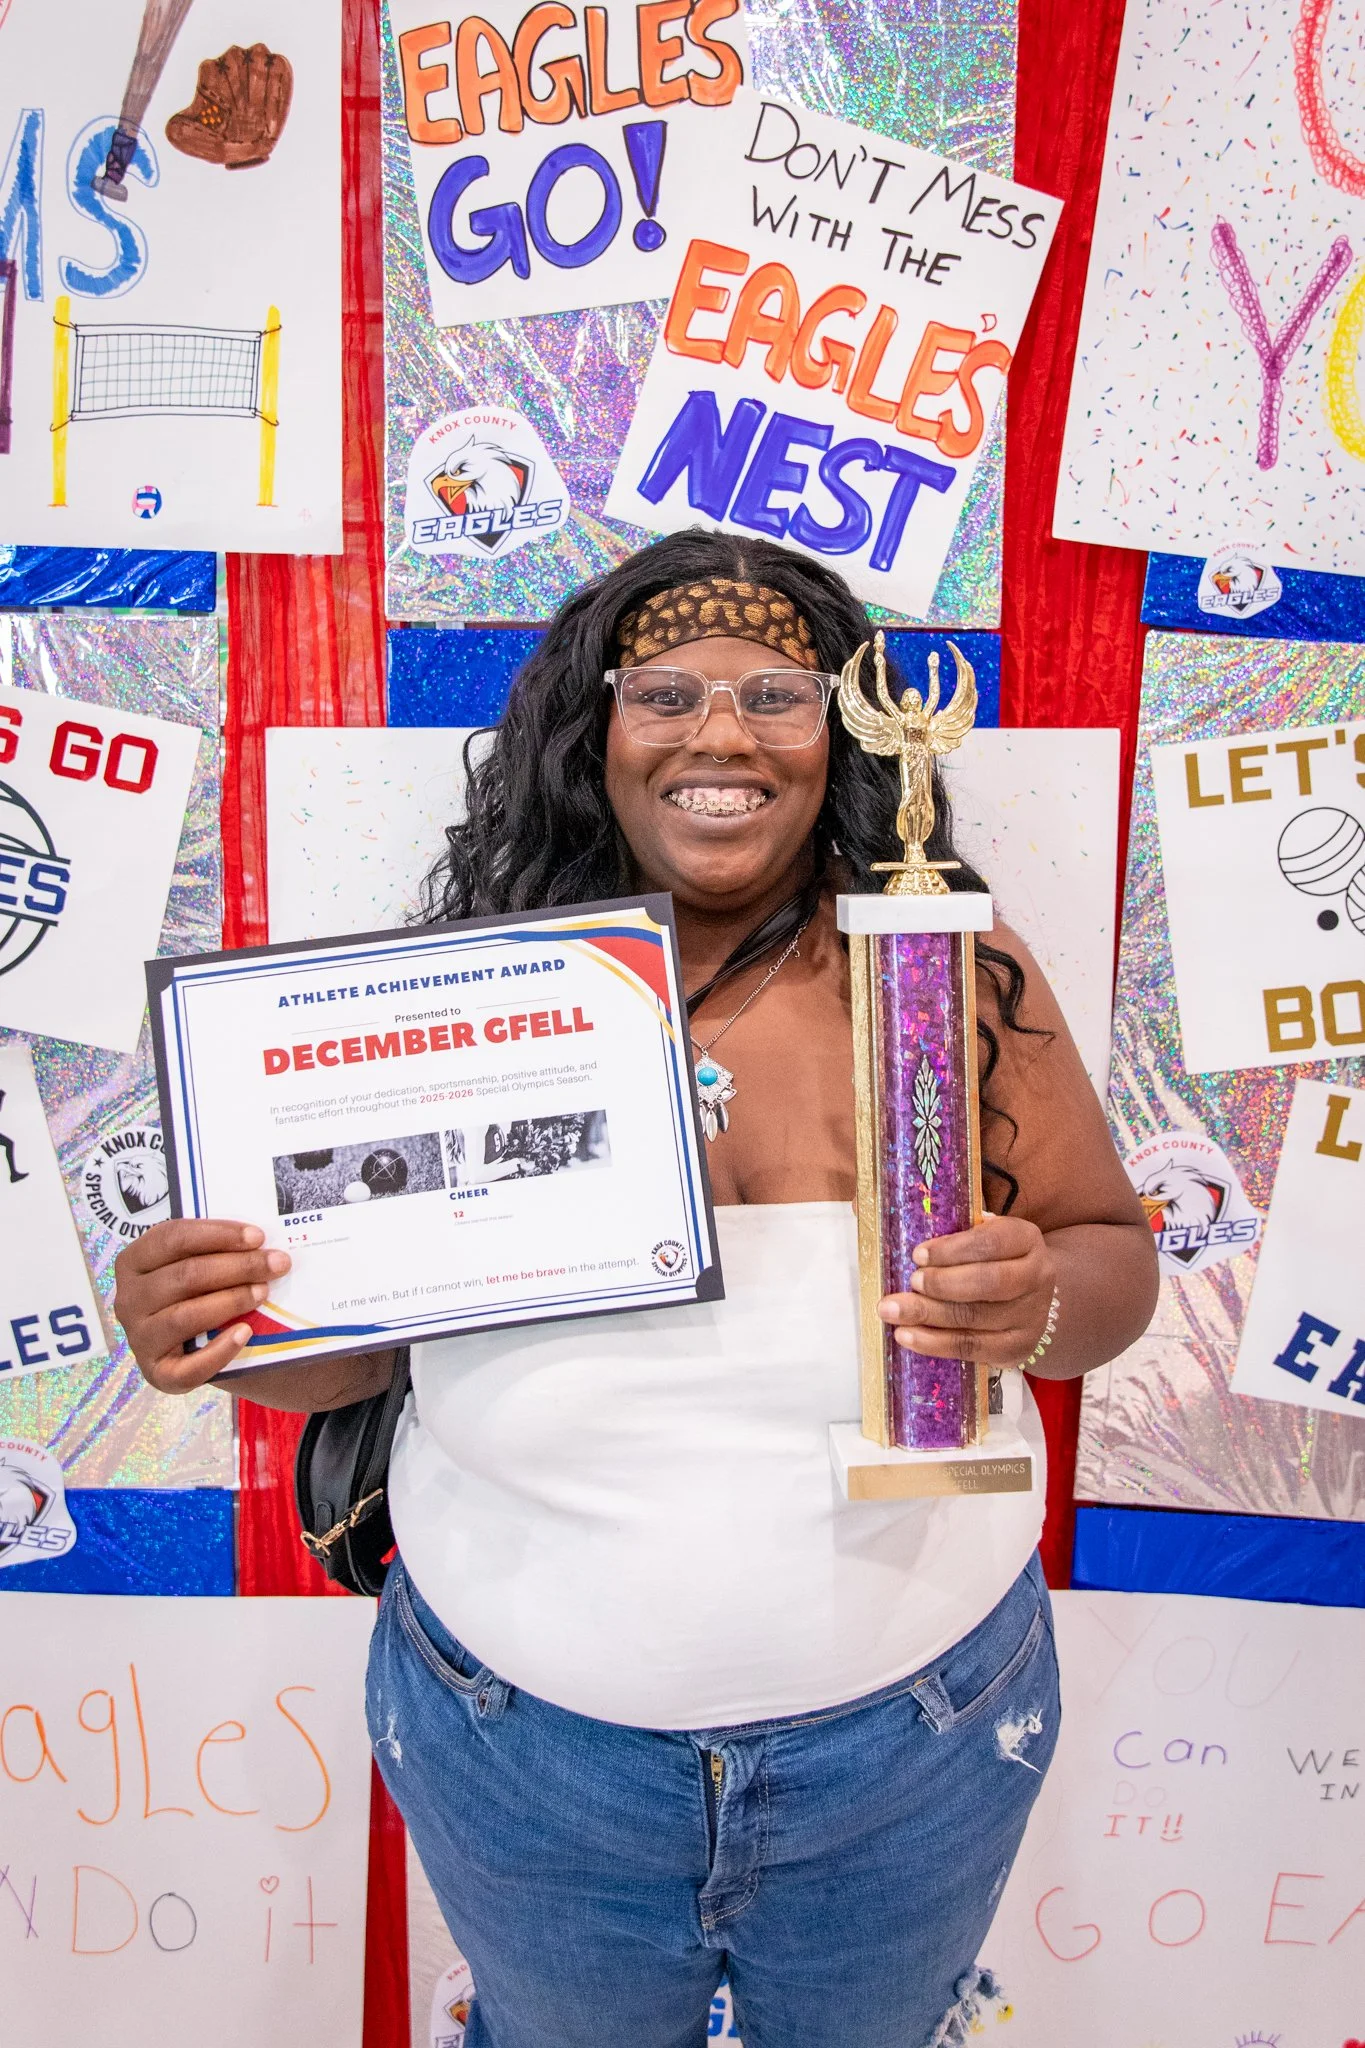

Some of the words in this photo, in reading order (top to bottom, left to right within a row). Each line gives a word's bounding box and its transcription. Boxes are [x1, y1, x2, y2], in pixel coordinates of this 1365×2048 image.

[398, 0, 744, 145] EAGLES
[745, 102, 905, 203] DON'T
[909, 166, 1045, 249] MESS
[428, 121, 668, 285] GO!
[752, 185, 852, 251] WITH
[882, 227, 961, 286] THE
[429, 420, 460, 444] KNOX
[464, 415, 517, 430] COUNTY
[637, 391, 956, 572] NEST
[412, 499, 562, 544] EAGLES
[1231, 543, 1259, 551] COUNTY
[1200, 587, 1279, 610] EAGLES
[49, 721, 158, 794] GO
[278, 986, 360, 1008] ATHLETE
[365, 968, 495, 996] ACHIEVEMENT
[500, 958, 566, 978] AWARD
[394, 1007, 448, 1023] Presented
[449, 1006, 461, 1016] to
[263, 1021, 477, 1076] DECEMBER
[483, 1006, 594, 1044] GFELL
[270, 1106, 280, 1115] In
[281, 1096, 337, 1112] recognition
[338, 1095, 349, 1104] of
[350, 1092, 372, 1104] your
[374, 1085, 427, 1100] dedication,
[428, 1075, 500, 1093] sportsmanship,
[501, 1069, 538, 1082] positive
[539, 1065, 578, 1077] attitude,
[579, 1060, 597, 1071] and
[275, 1112, 317, 1125] fantastic
[318, 1107, 344, 1119] effort
[346, 1100, 400, 1114] throughout
[402, 1096, 417, 1107] the
[420, 1089, 474, 1104] 2025-2026
[476, 1083, 510, 1096] Special
[511, 1078, 554, 1093] Olympics
[556, 1074, 593, 1085] Season.
[101, 1132, 146, 1158] KNOX
[1128, 1144, 1158, 1167] KNOX
[1162, 1140, 1214, 1154] COUNTY
[85, 1172, 118, 1230] SPECIAL
[284, 1214, 323, 1227] BOCCE
[449, 1188, 489, 1200] CHEER
[453, 1210, 464, 1219] 12
[1156, 1218, 1257, 1252] GLES
[331, 1300, 348, 1311] Let
[350, 1297, 366, 1307] me
[368, 1293, 390, 1305] win.
[392, 1289, 409, 1300] But
[411, 1286, 418, 1297] if
[425, 1280, 461, 1295] cannot
[463, 1278, 484, 1289] win,
[486, 1274, 500, 1285] let
[502, 1272, 519, 1282] me
[521, 1270, 534, 1280] be
[536, 1266, 566, 1278] brave
[568, 1265, 578, 1274] in
[579, 1262, 596, 1273] the
[598, 1257, 639, 1271] attempt.
[942, 1464, 977, 1477] SPECIAL
[981, 1463, 1026, 1477] OLYMPICS
[1088, 1603, 1300, 1709] YOU
[1113, 1730, 1226, 1769] Can
